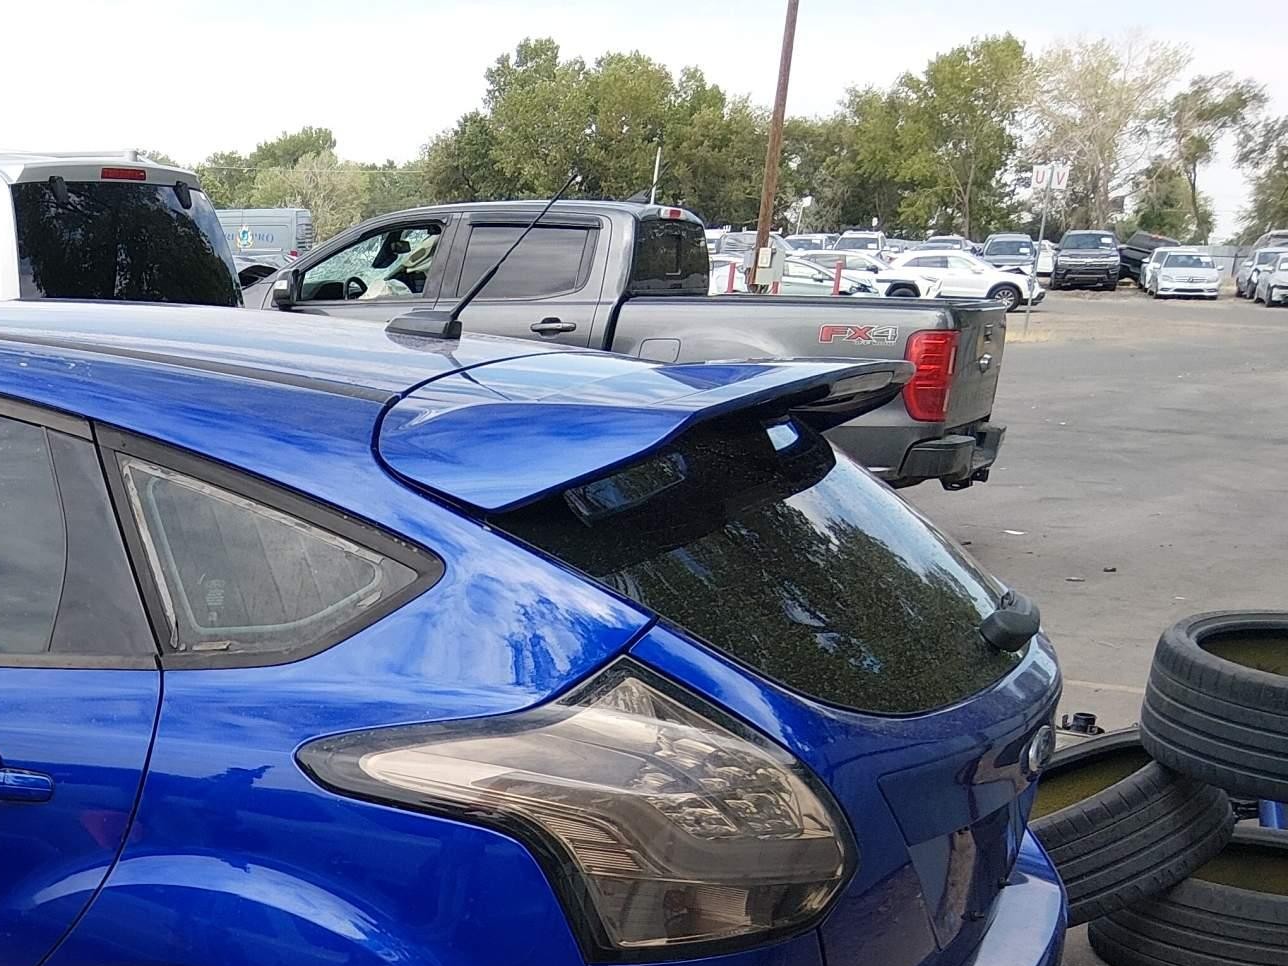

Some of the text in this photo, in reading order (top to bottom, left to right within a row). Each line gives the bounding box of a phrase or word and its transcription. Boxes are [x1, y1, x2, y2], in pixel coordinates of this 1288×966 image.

[1036, 170, 1045, 184] U
[1056, 172, 1065, 185] V
[819, 324, 898, 343] FX4
